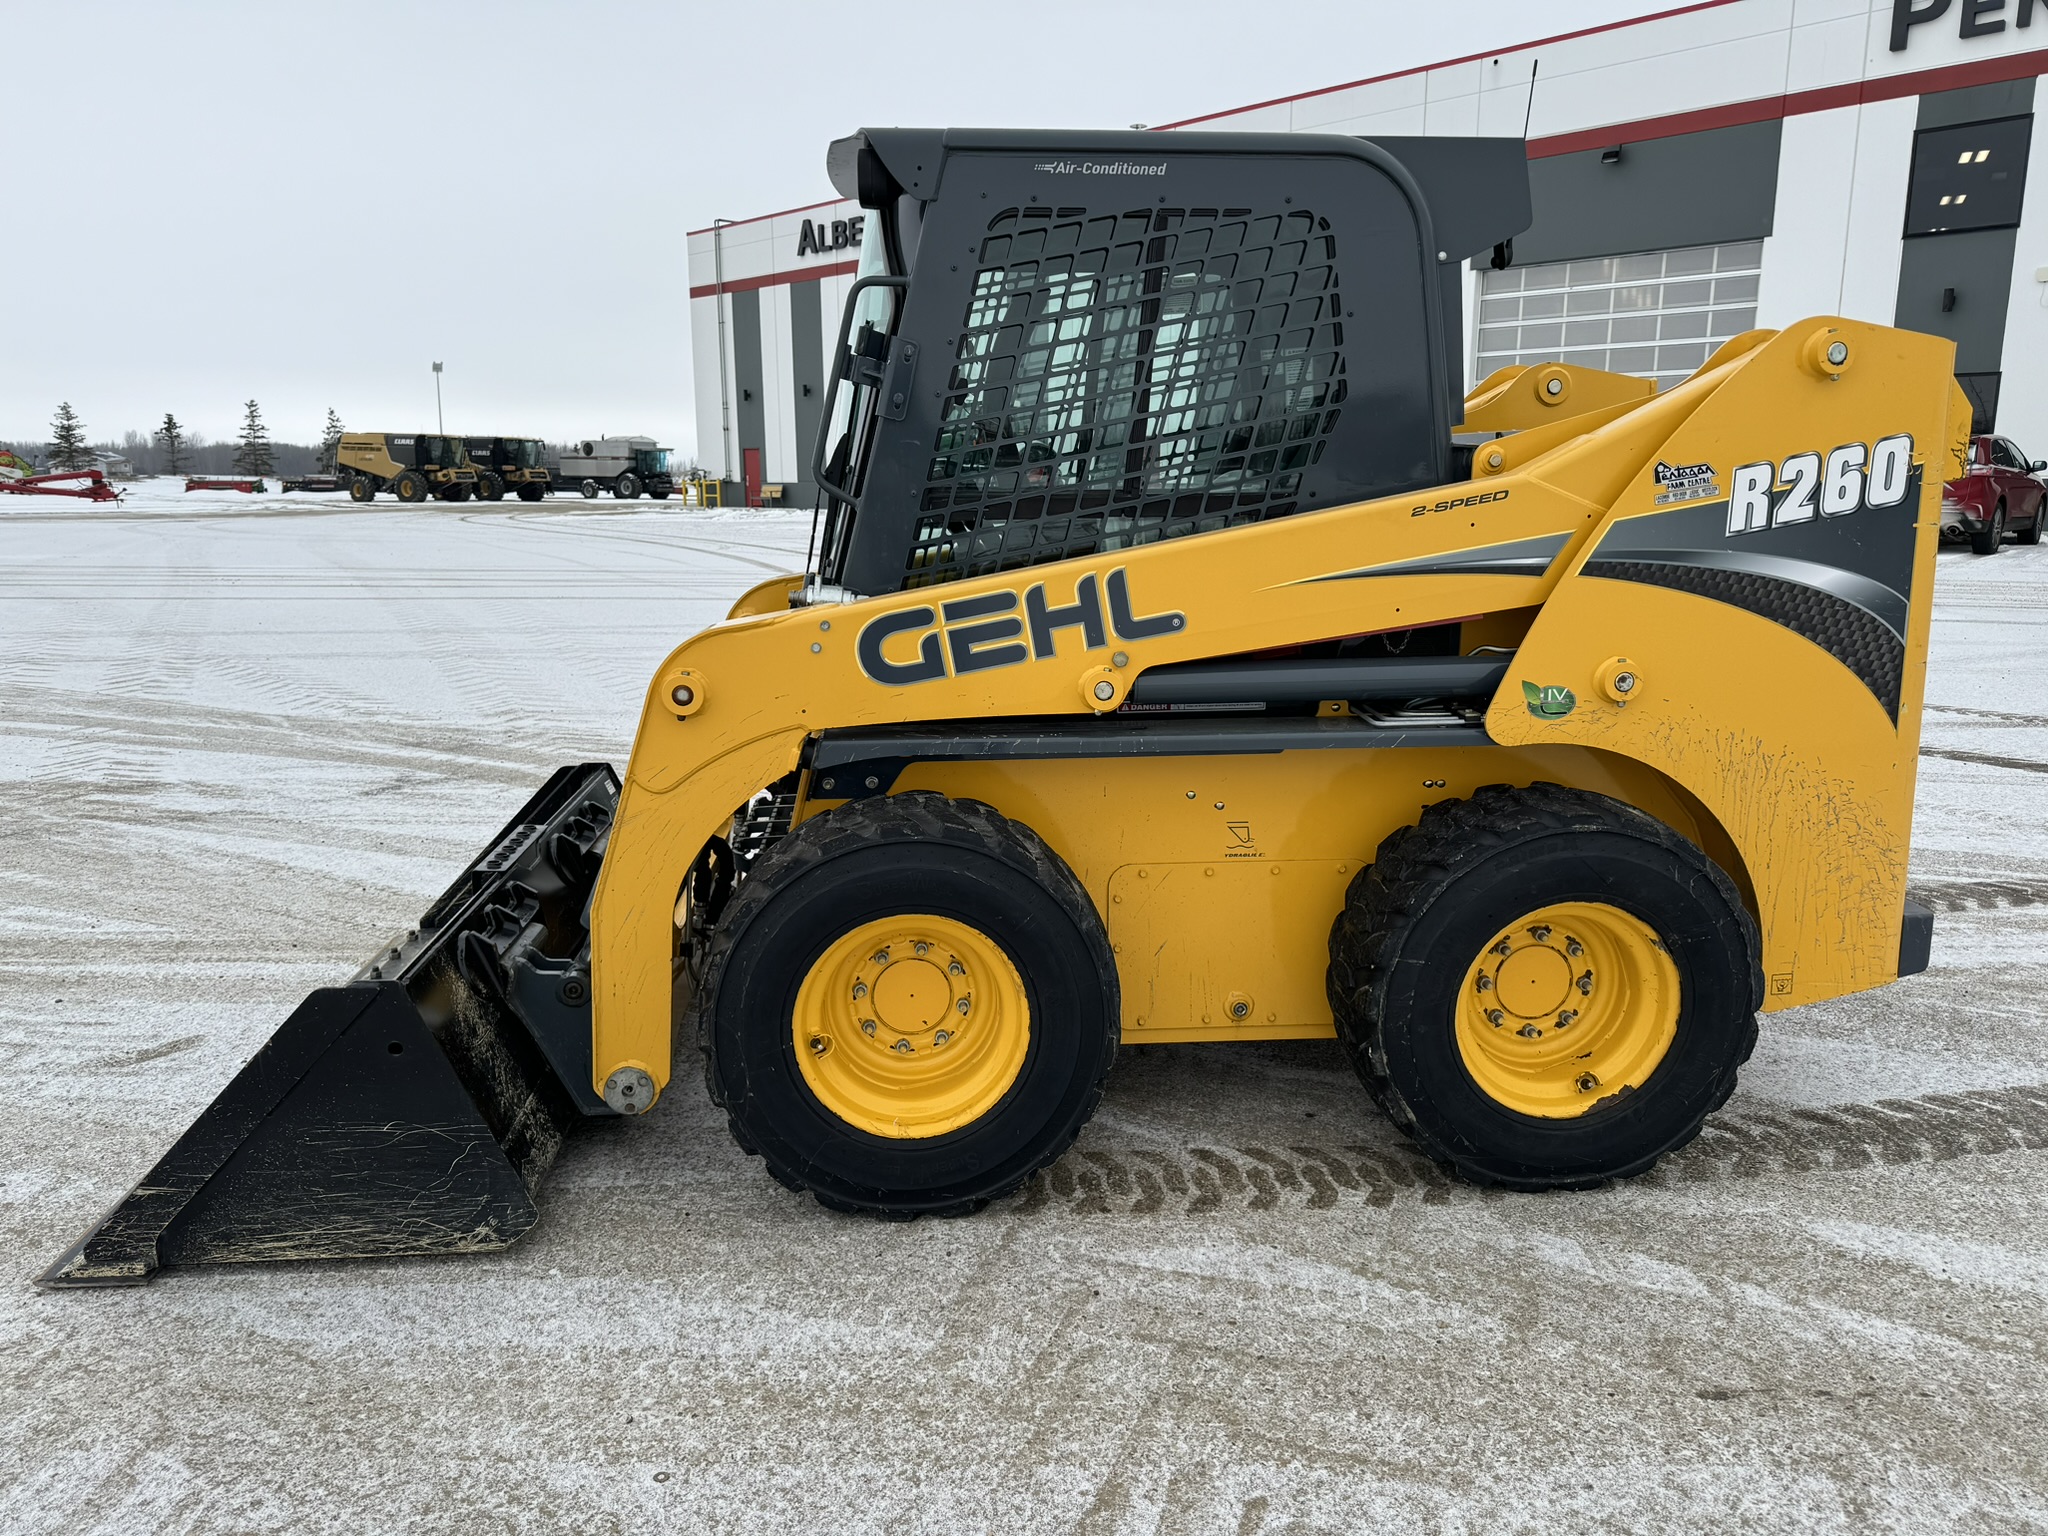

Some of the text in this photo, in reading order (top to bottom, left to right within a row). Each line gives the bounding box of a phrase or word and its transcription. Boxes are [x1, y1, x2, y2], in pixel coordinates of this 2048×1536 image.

[1055, 161, 1167, 175] Air-Conditioned
[1667, 477, 1711, 490] FARM CENTRE
[1725, 432, 1914, 538] R260
[1411, 490, 1509, 517] 2-SPEED
[855, 565, 1187, 687] GEHL
